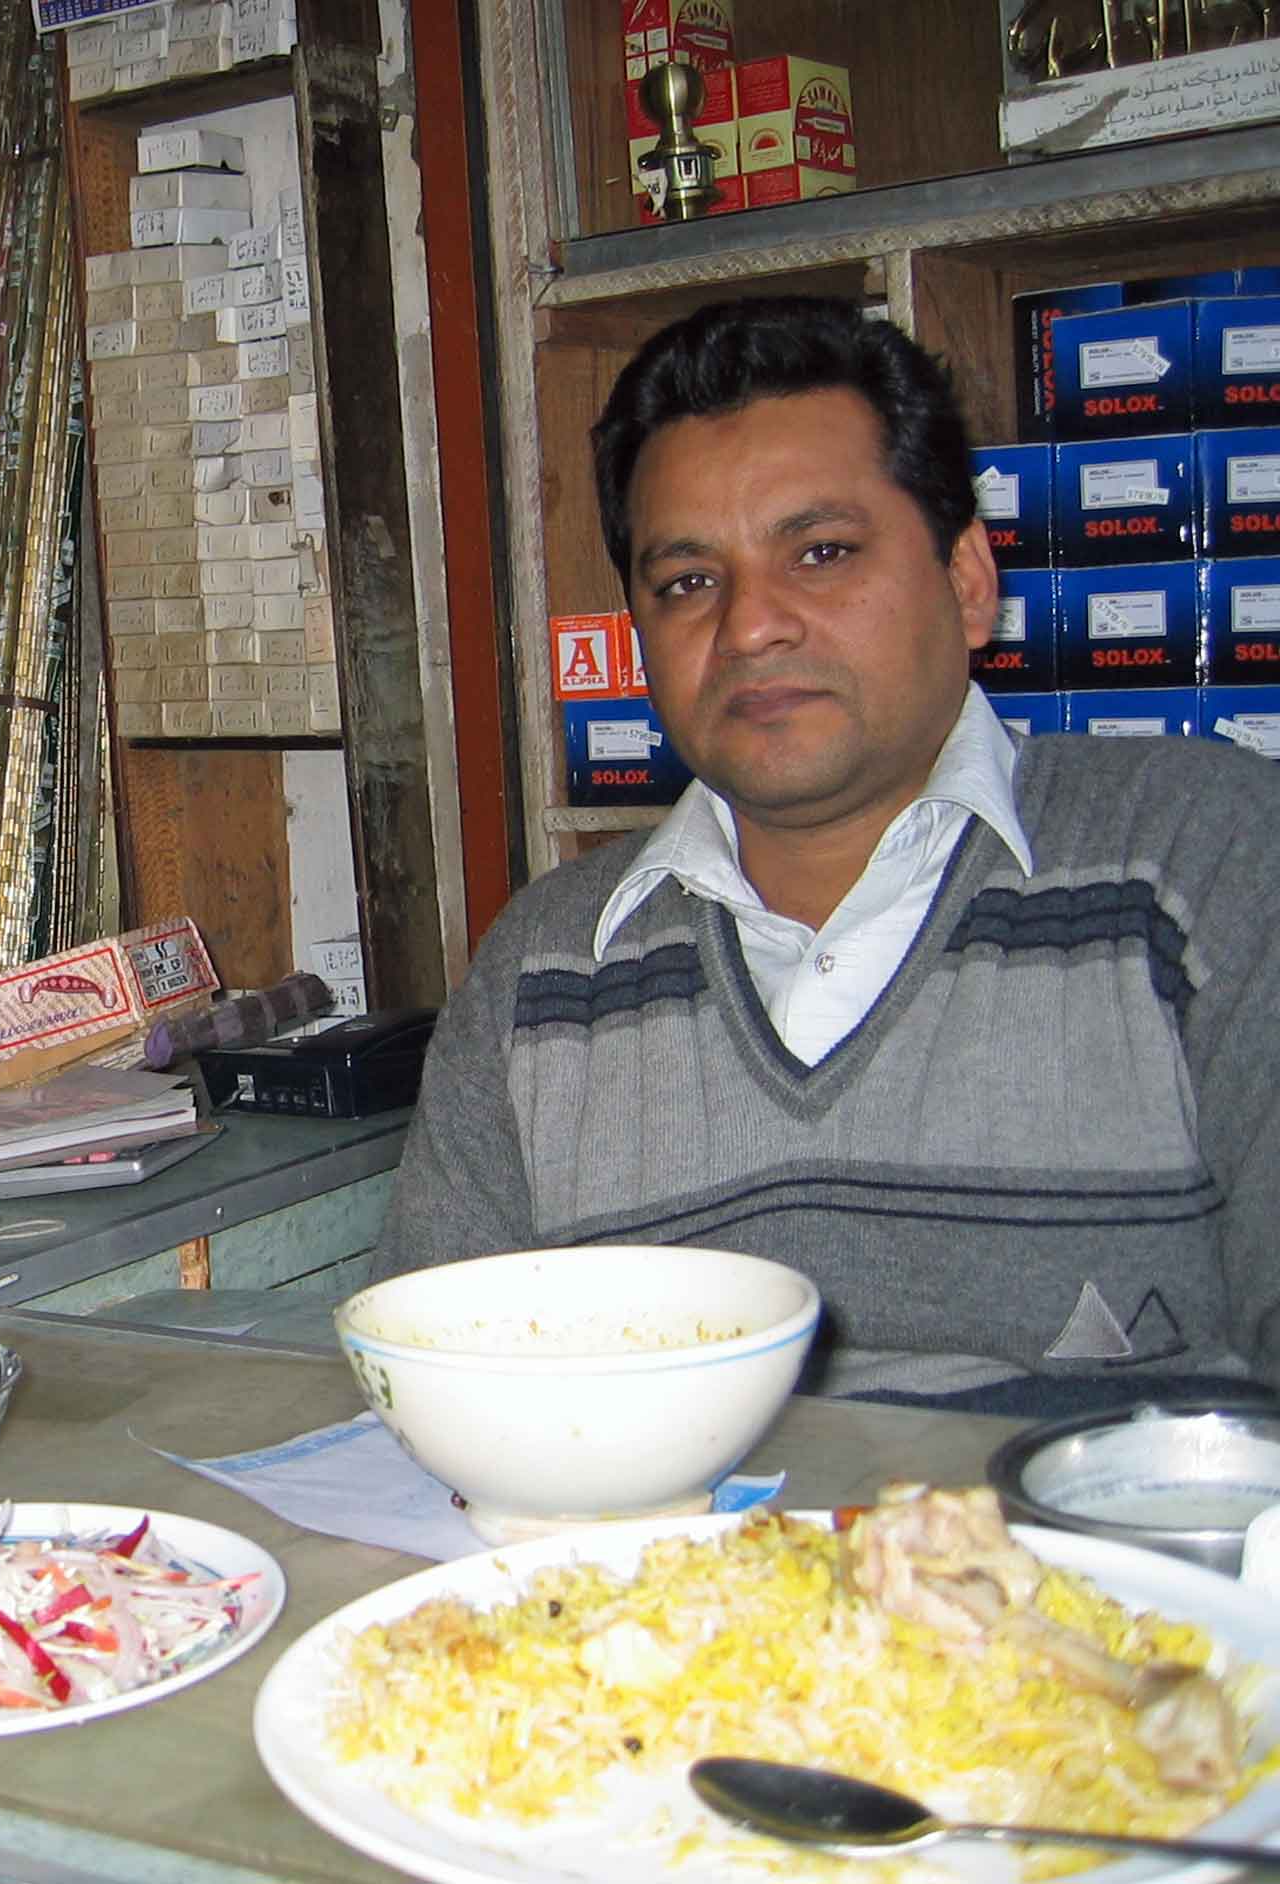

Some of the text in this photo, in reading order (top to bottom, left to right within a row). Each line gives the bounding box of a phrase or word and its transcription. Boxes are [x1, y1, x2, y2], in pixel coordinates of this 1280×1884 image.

[1084, 395, 1158, 417] SOLOX
[1085, 516, 1158, 537] SOLOX
[1092, 648, 1165, 668] SOLOX
[562, 675, 606, 687] ALPHA
[592, 770, 650, 785] SOLOX
